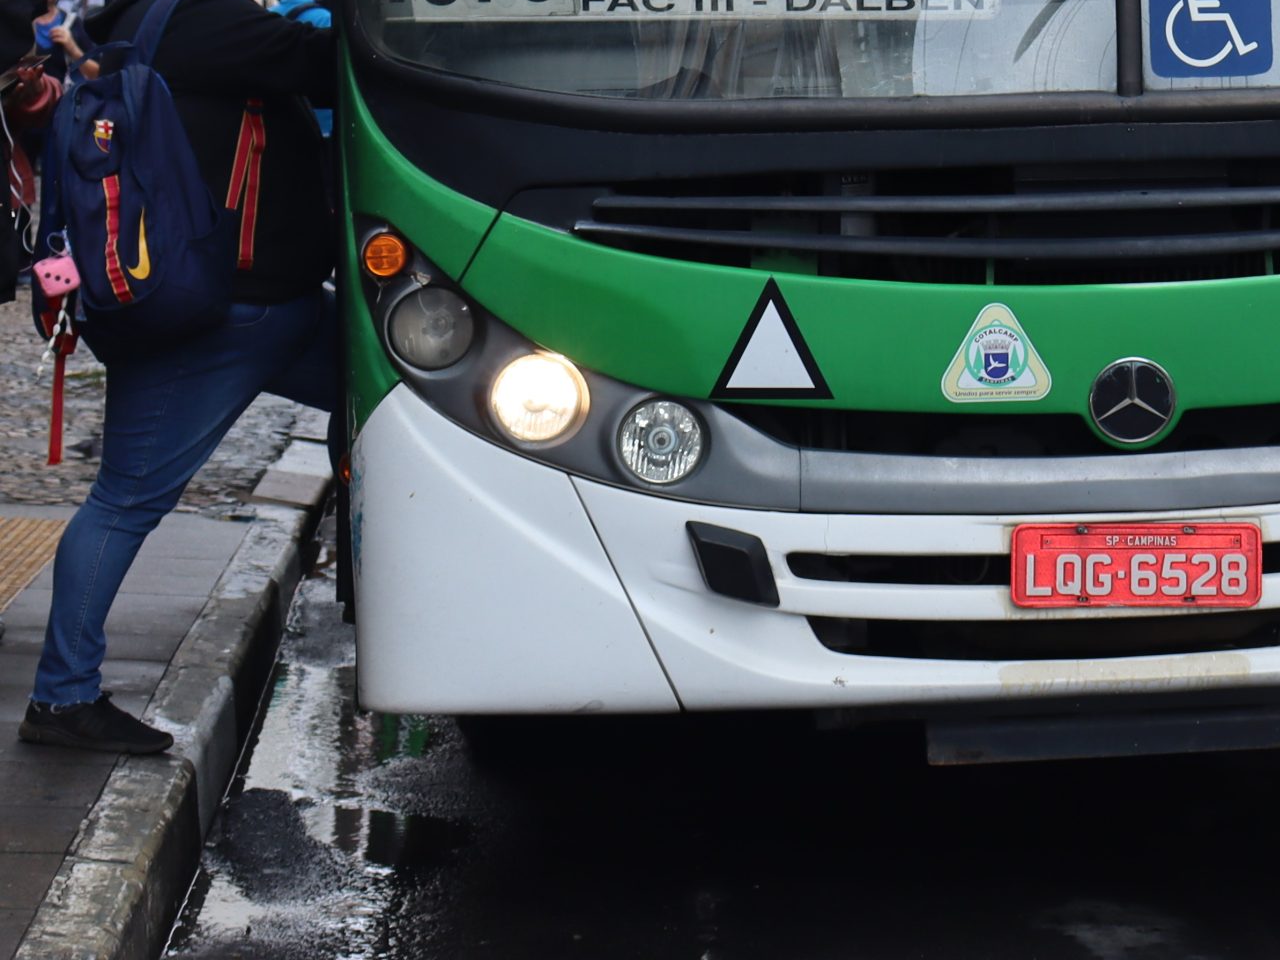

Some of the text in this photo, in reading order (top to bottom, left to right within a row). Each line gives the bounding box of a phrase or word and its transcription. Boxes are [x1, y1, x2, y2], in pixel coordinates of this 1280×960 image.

[975, 328, 1019, 343] COTALCAMP
[1106, 535, 1120, 546] SP
[1127, 535, 1177, 546] CAMPINAS
